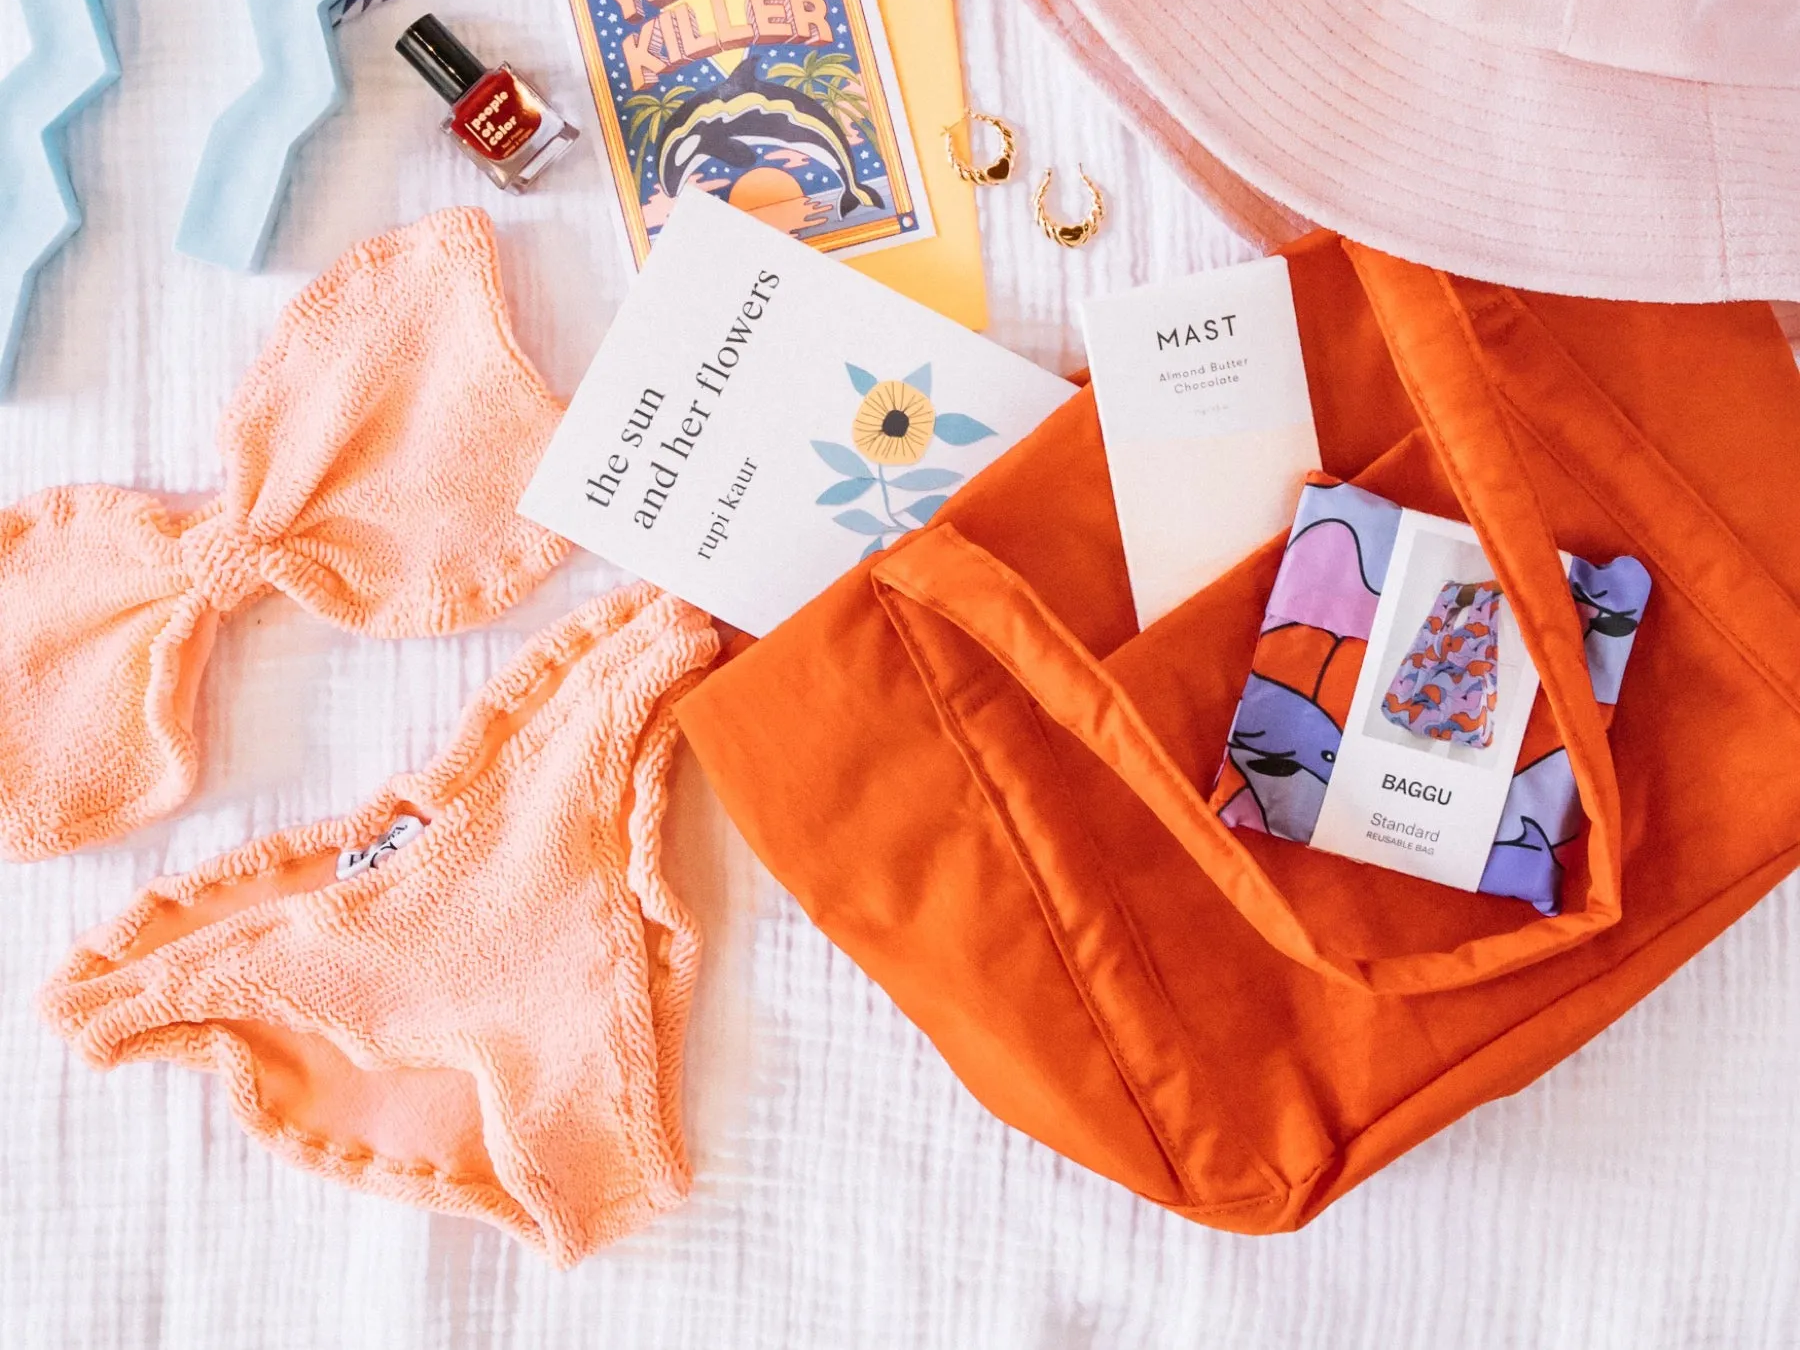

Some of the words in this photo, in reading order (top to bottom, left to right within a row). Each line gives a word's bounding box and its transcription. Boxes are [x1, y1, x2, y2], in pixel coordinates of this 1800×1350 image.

[471, 91, 508, 130] people
[482, 121, 495, 138] of
[489, 116, 517, 146] color
[1157, 315, 1236, 350] MAST
[1160, 365, 1205, 382] Almond
[1210, 358, 1248, 372] Butter
[1174, 375, 1239, 394] Chocolate
[634, 462, 679, 529] and
[660, 400, 711, 460] her
[695, 270, 780, 397] flowers
[586, 453, 629, 508] the
[621, 387, 666, 448] sun
[698, 511, 730, 560] rupi
[718, 457, 758, 510] kaur
[1382, 774, 1452, 805] BAGGU
[1370, 812, 1440, 842] Standard
[1366, 831, 1413, 850] REUSABLE
[1415, 844, 1434, 855] BAG
